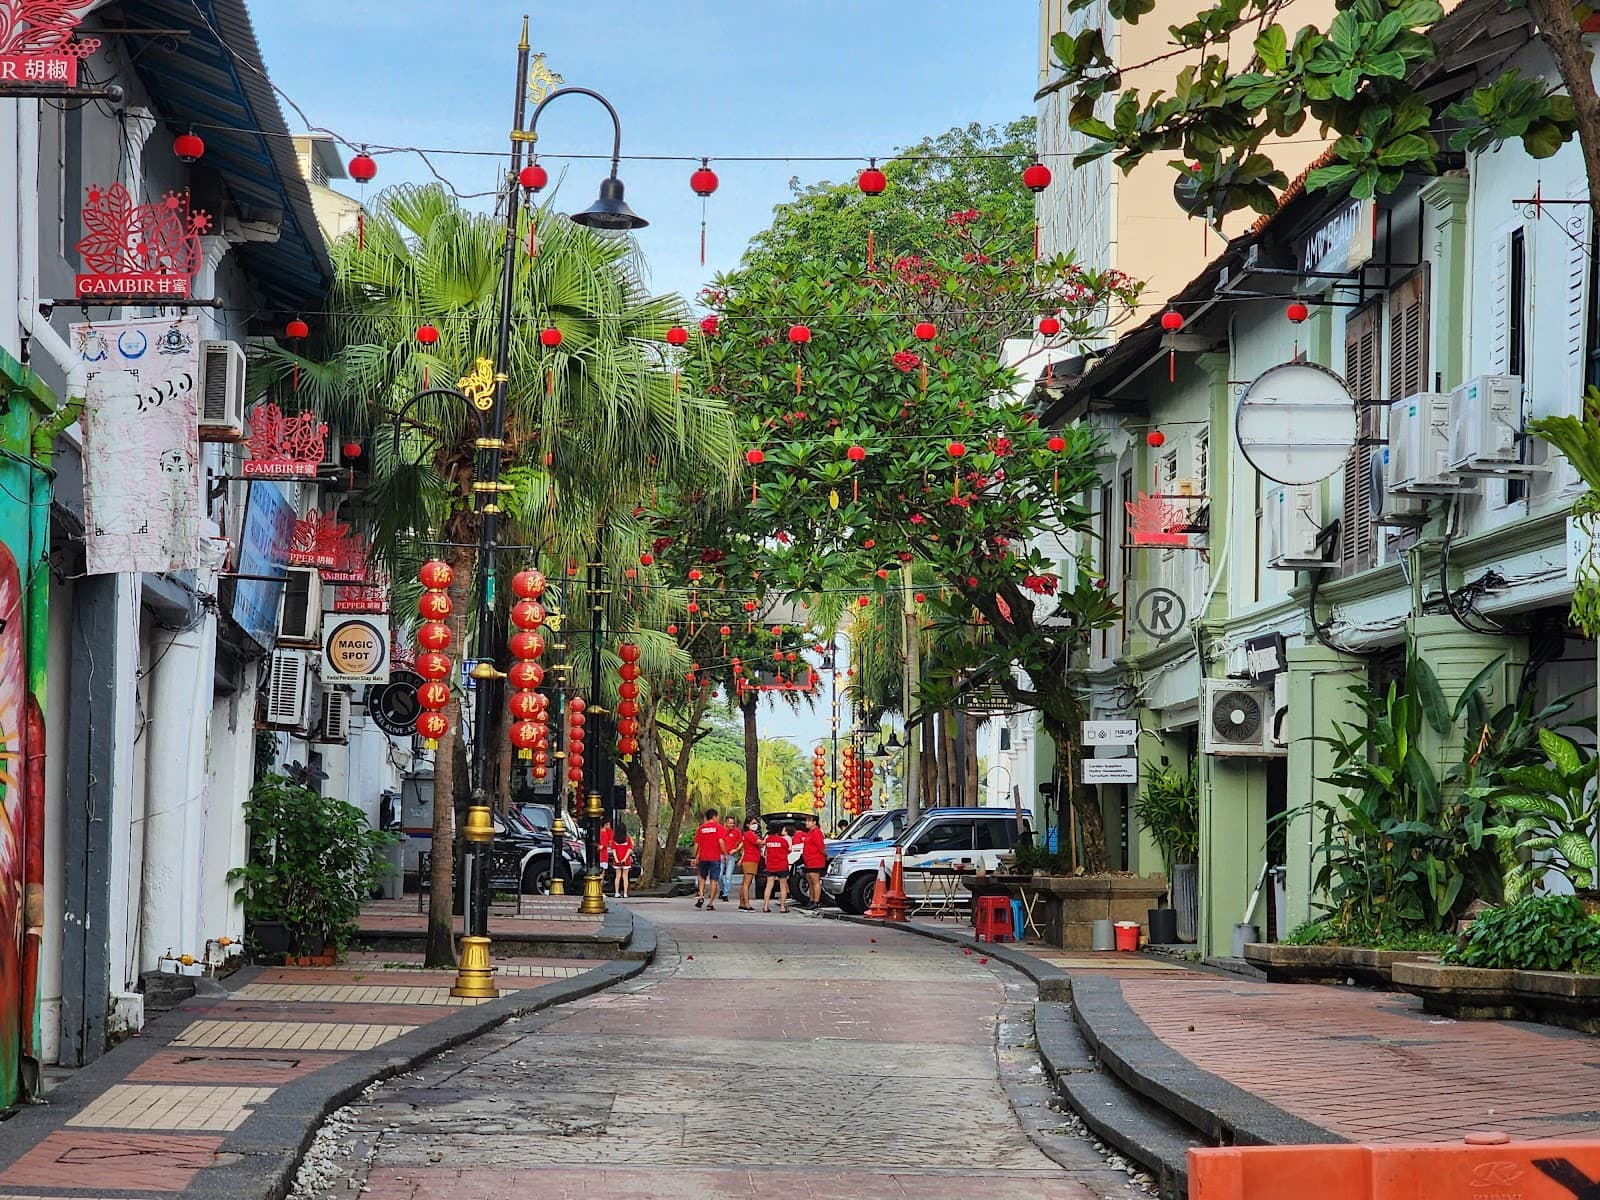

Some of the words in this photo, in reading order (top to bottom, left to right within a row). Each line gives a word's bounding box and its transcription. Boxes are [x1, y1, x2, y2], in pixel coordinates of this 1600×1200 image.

[24, 59, 68, 80] 胡椒
[1326, 199, 1364, 256] BEAUTY
[79, 278, 156, 293] GAMBIR
[157, 278, 187, 293] 甘蜜
[245, 463, 294, 474] GAMBIR
[337, 601, 366, 609] PEPPER
[339, 640, 373, 649] MAGIC
[342, 651, 370, 660] SPOT
